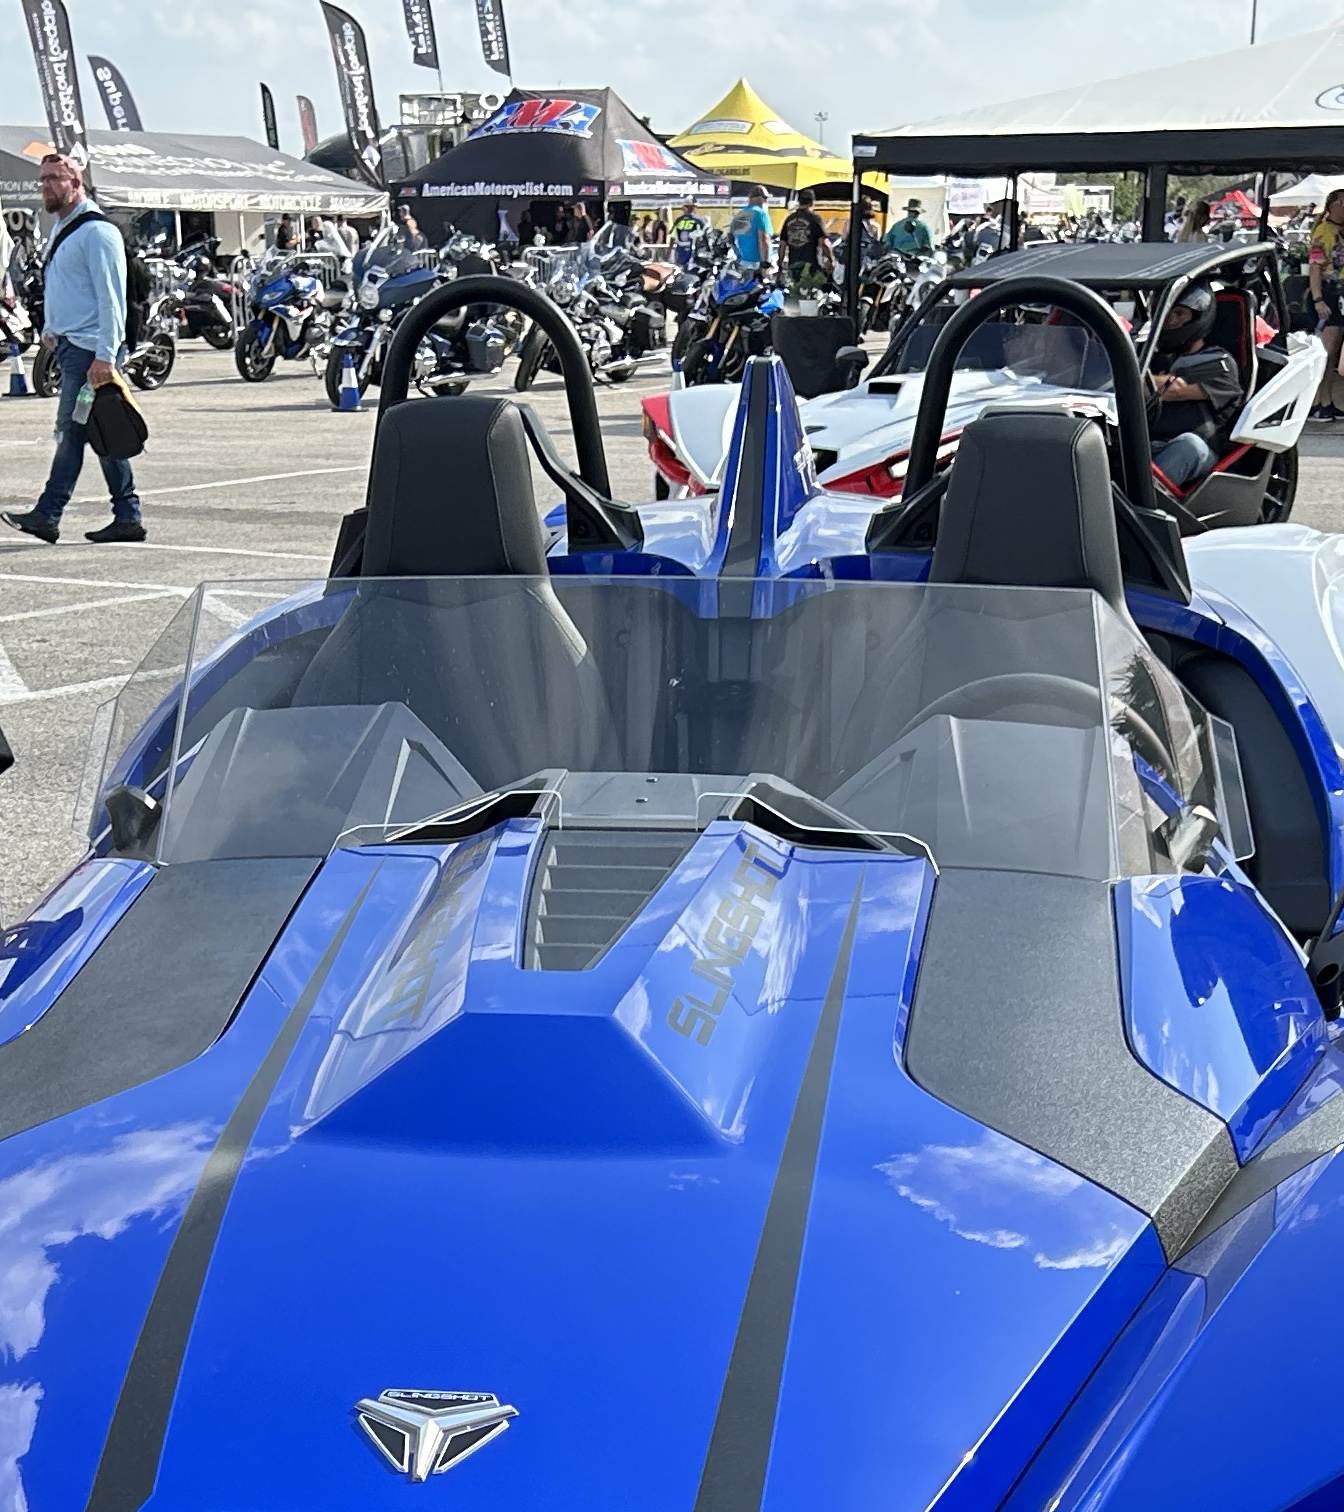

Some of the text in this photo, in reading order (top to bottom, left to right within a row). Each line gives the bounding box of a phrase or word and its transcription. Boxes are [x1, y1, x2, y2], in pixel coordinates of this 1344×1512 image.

[421, 181, 575, 199] AmericanMotorcyclist.com
[666, 841, 785, 1047] SLINGSHOT
[387, 1391, 492, 1402] SLINGSHOT
